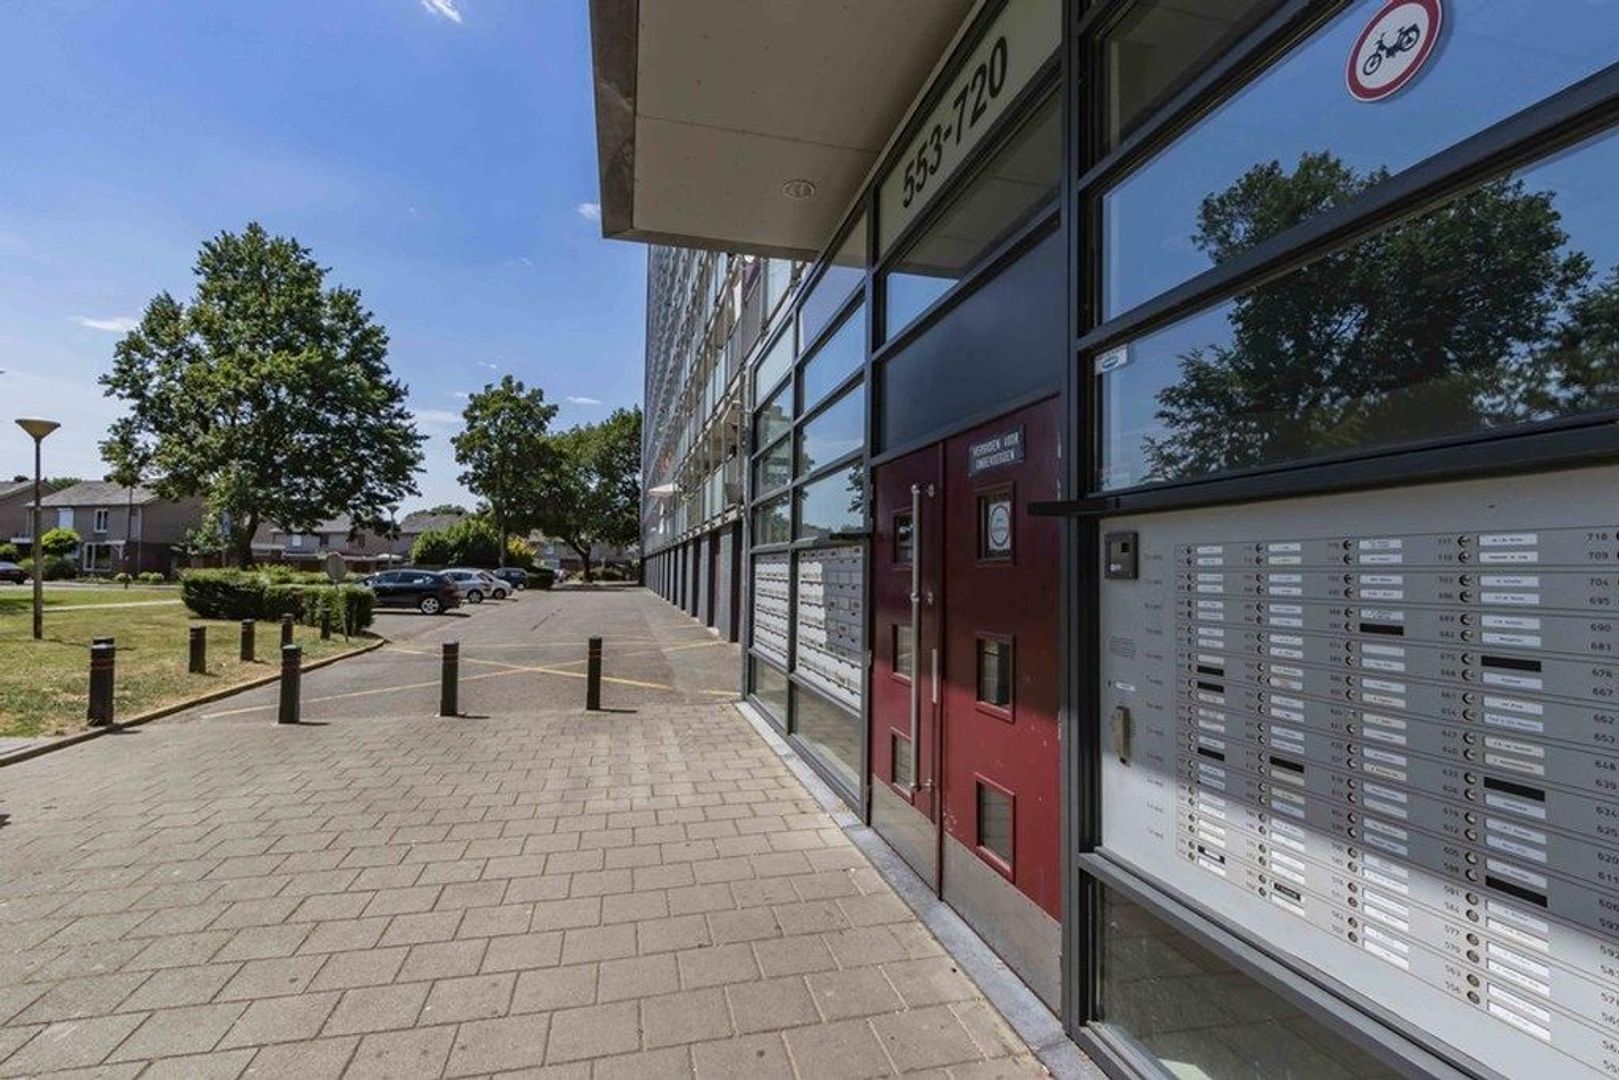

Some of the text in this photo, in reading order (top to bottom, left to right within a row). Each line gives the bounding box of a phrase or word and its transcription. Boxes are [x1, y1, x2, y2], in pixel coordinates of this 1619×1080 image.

[903, 36, 1007, 208] 553-720
[1588, 551, 1609, 560] 709
[1589, 578, 1609, 586] 704
[1589, 597, 1609, 606] 695
[1590, 623, 1612, 632] 690
[1593, 687, 1613, 696] 667
[1594, 713, 1614, 724] 662
[1594, 733, 1615, 743] 653
[1596, 806, 1618, 818] 634
[1597, 824, 1618, 837] 625
[1597, 852, 1619, 865] 620
[1598, 871, 1618, 884] 611
